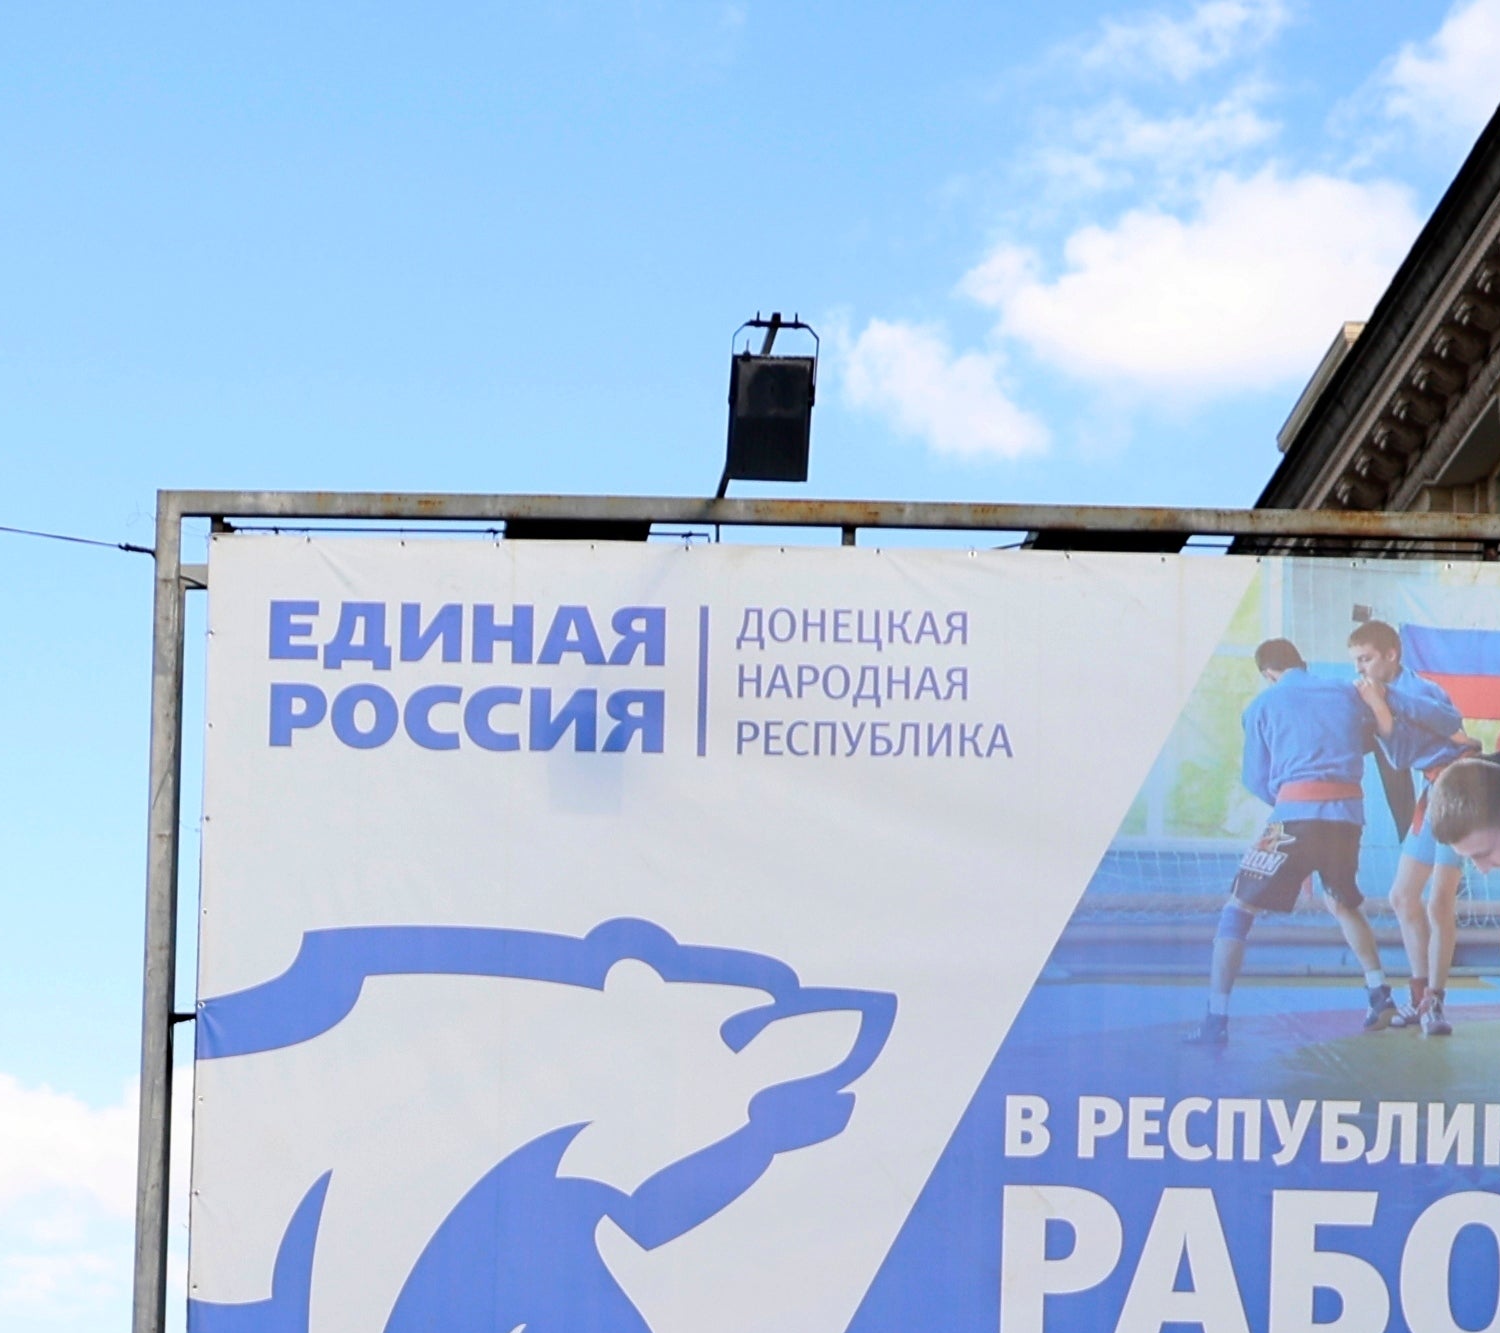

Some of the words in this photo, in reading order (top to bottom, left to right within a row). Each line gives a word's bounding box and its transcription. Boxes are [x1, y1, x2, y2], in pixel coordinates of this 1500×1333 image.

[269, 600, 666, 671] ЕДИНАЯ
[736, 607, 968, 651] ДОНЕЦКАЯ
[737, 663, 968, 708] НАРОДНАЯ
[269, 682, 665, 753] РОССИЯ
[736, 720, 1014, 758] РЕСПУБЛИКА
[1004, 1095, 1050, 1157] В
